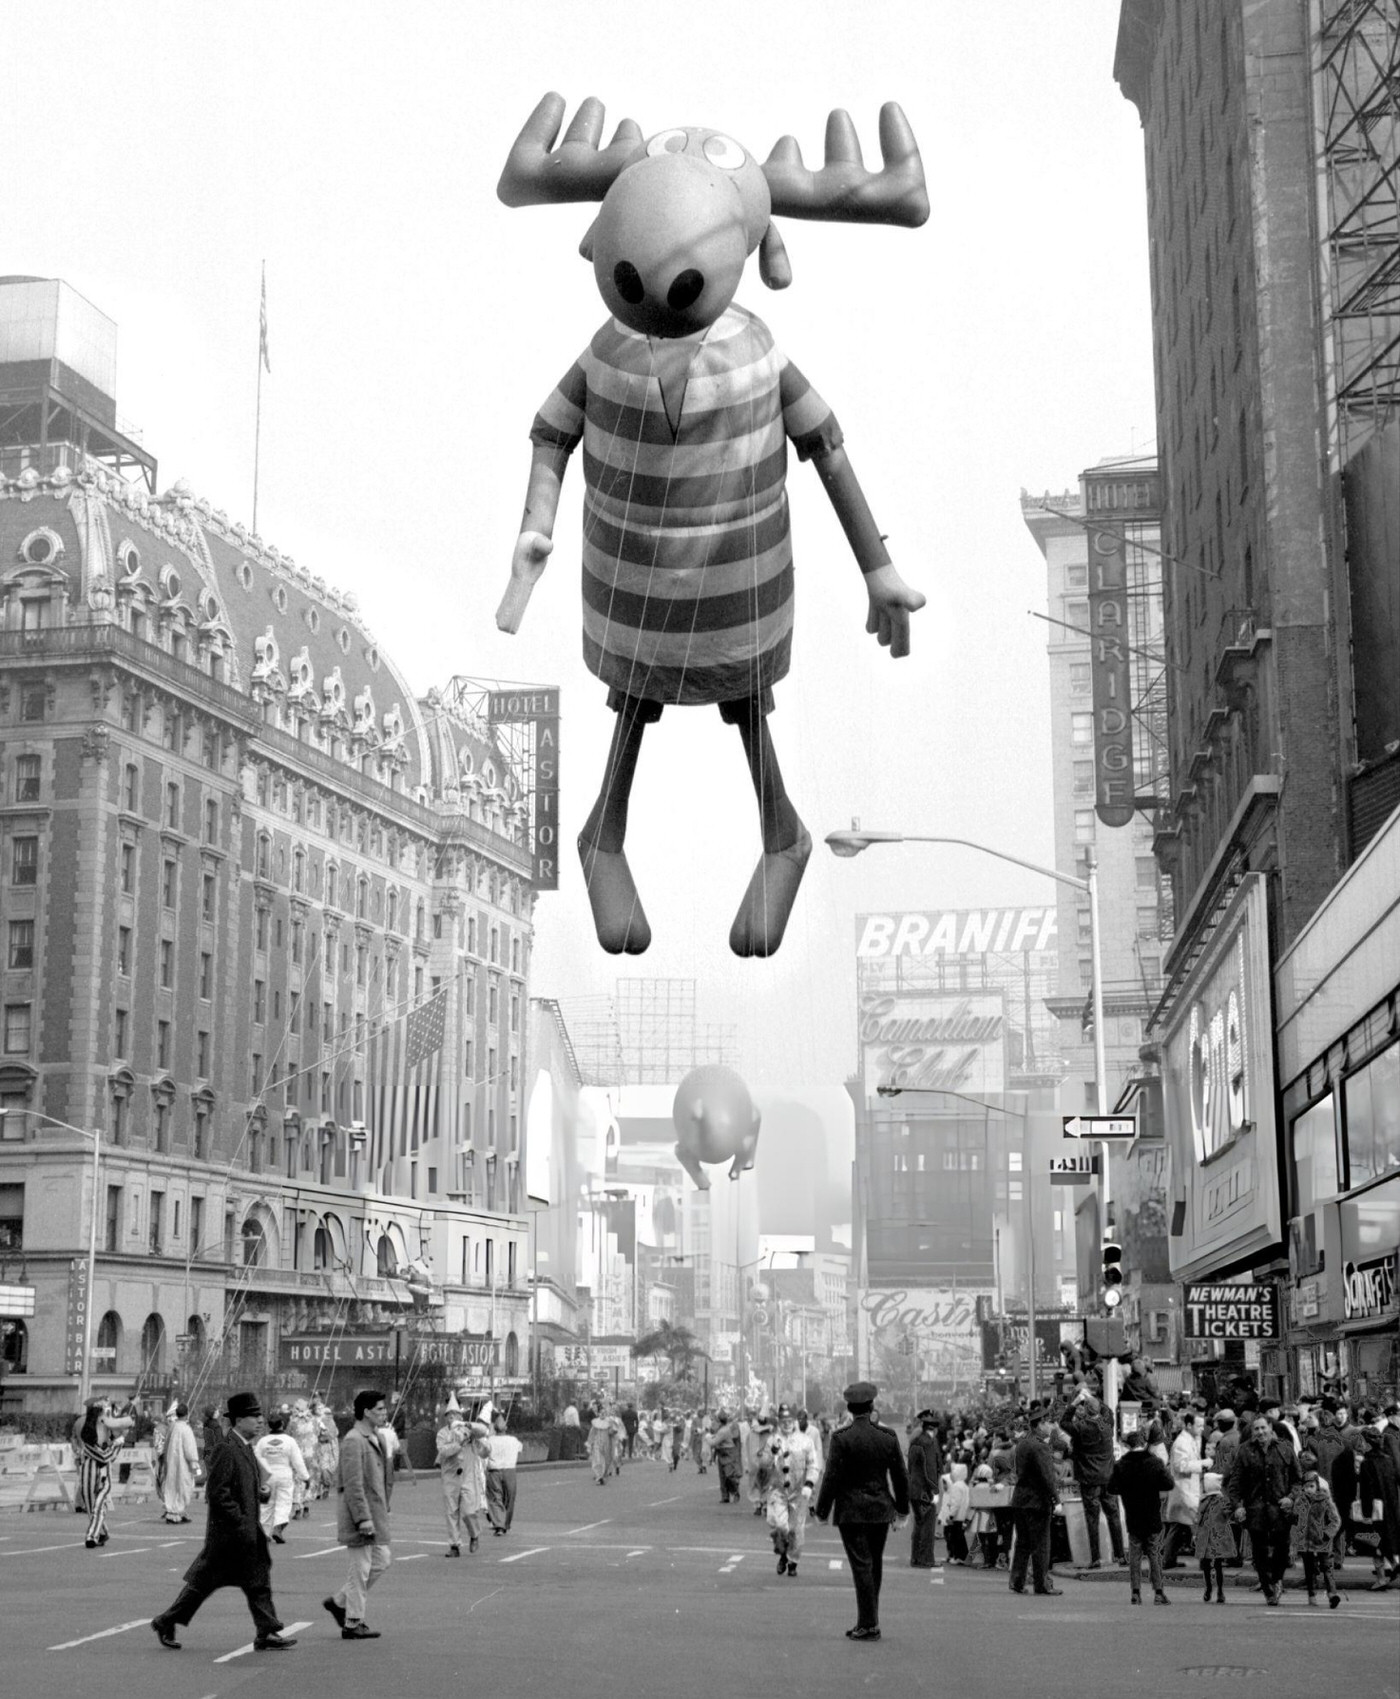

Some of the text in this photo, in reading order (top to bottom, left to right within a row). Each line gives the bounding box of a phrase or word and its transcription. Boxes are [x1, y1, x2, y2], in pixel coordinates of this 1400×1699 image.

[1093, 528, 1129, 806] CLARIDGE
[493, 694, 554, 715] HOTEL
[538, 728, 554, 878] ASTOR
[859, 995, 1003, 1043] Canadian
[76, 1261, 87, 1326] ASTOR
[1188, 1286, 1273, 1302] NEWMAN'S
[861, 1291, 976, 1328] Castr
[1187, 1304, 1273, 1321] THEATRE
[1191, 1320, 1273, 1336] TICKETS
[74, 1333, 84, 1371] BAR
[291, 1345, 407, 1361] HOTEL ASTO
[421, 1342, 495, 1366] HOTEL ASTOR
